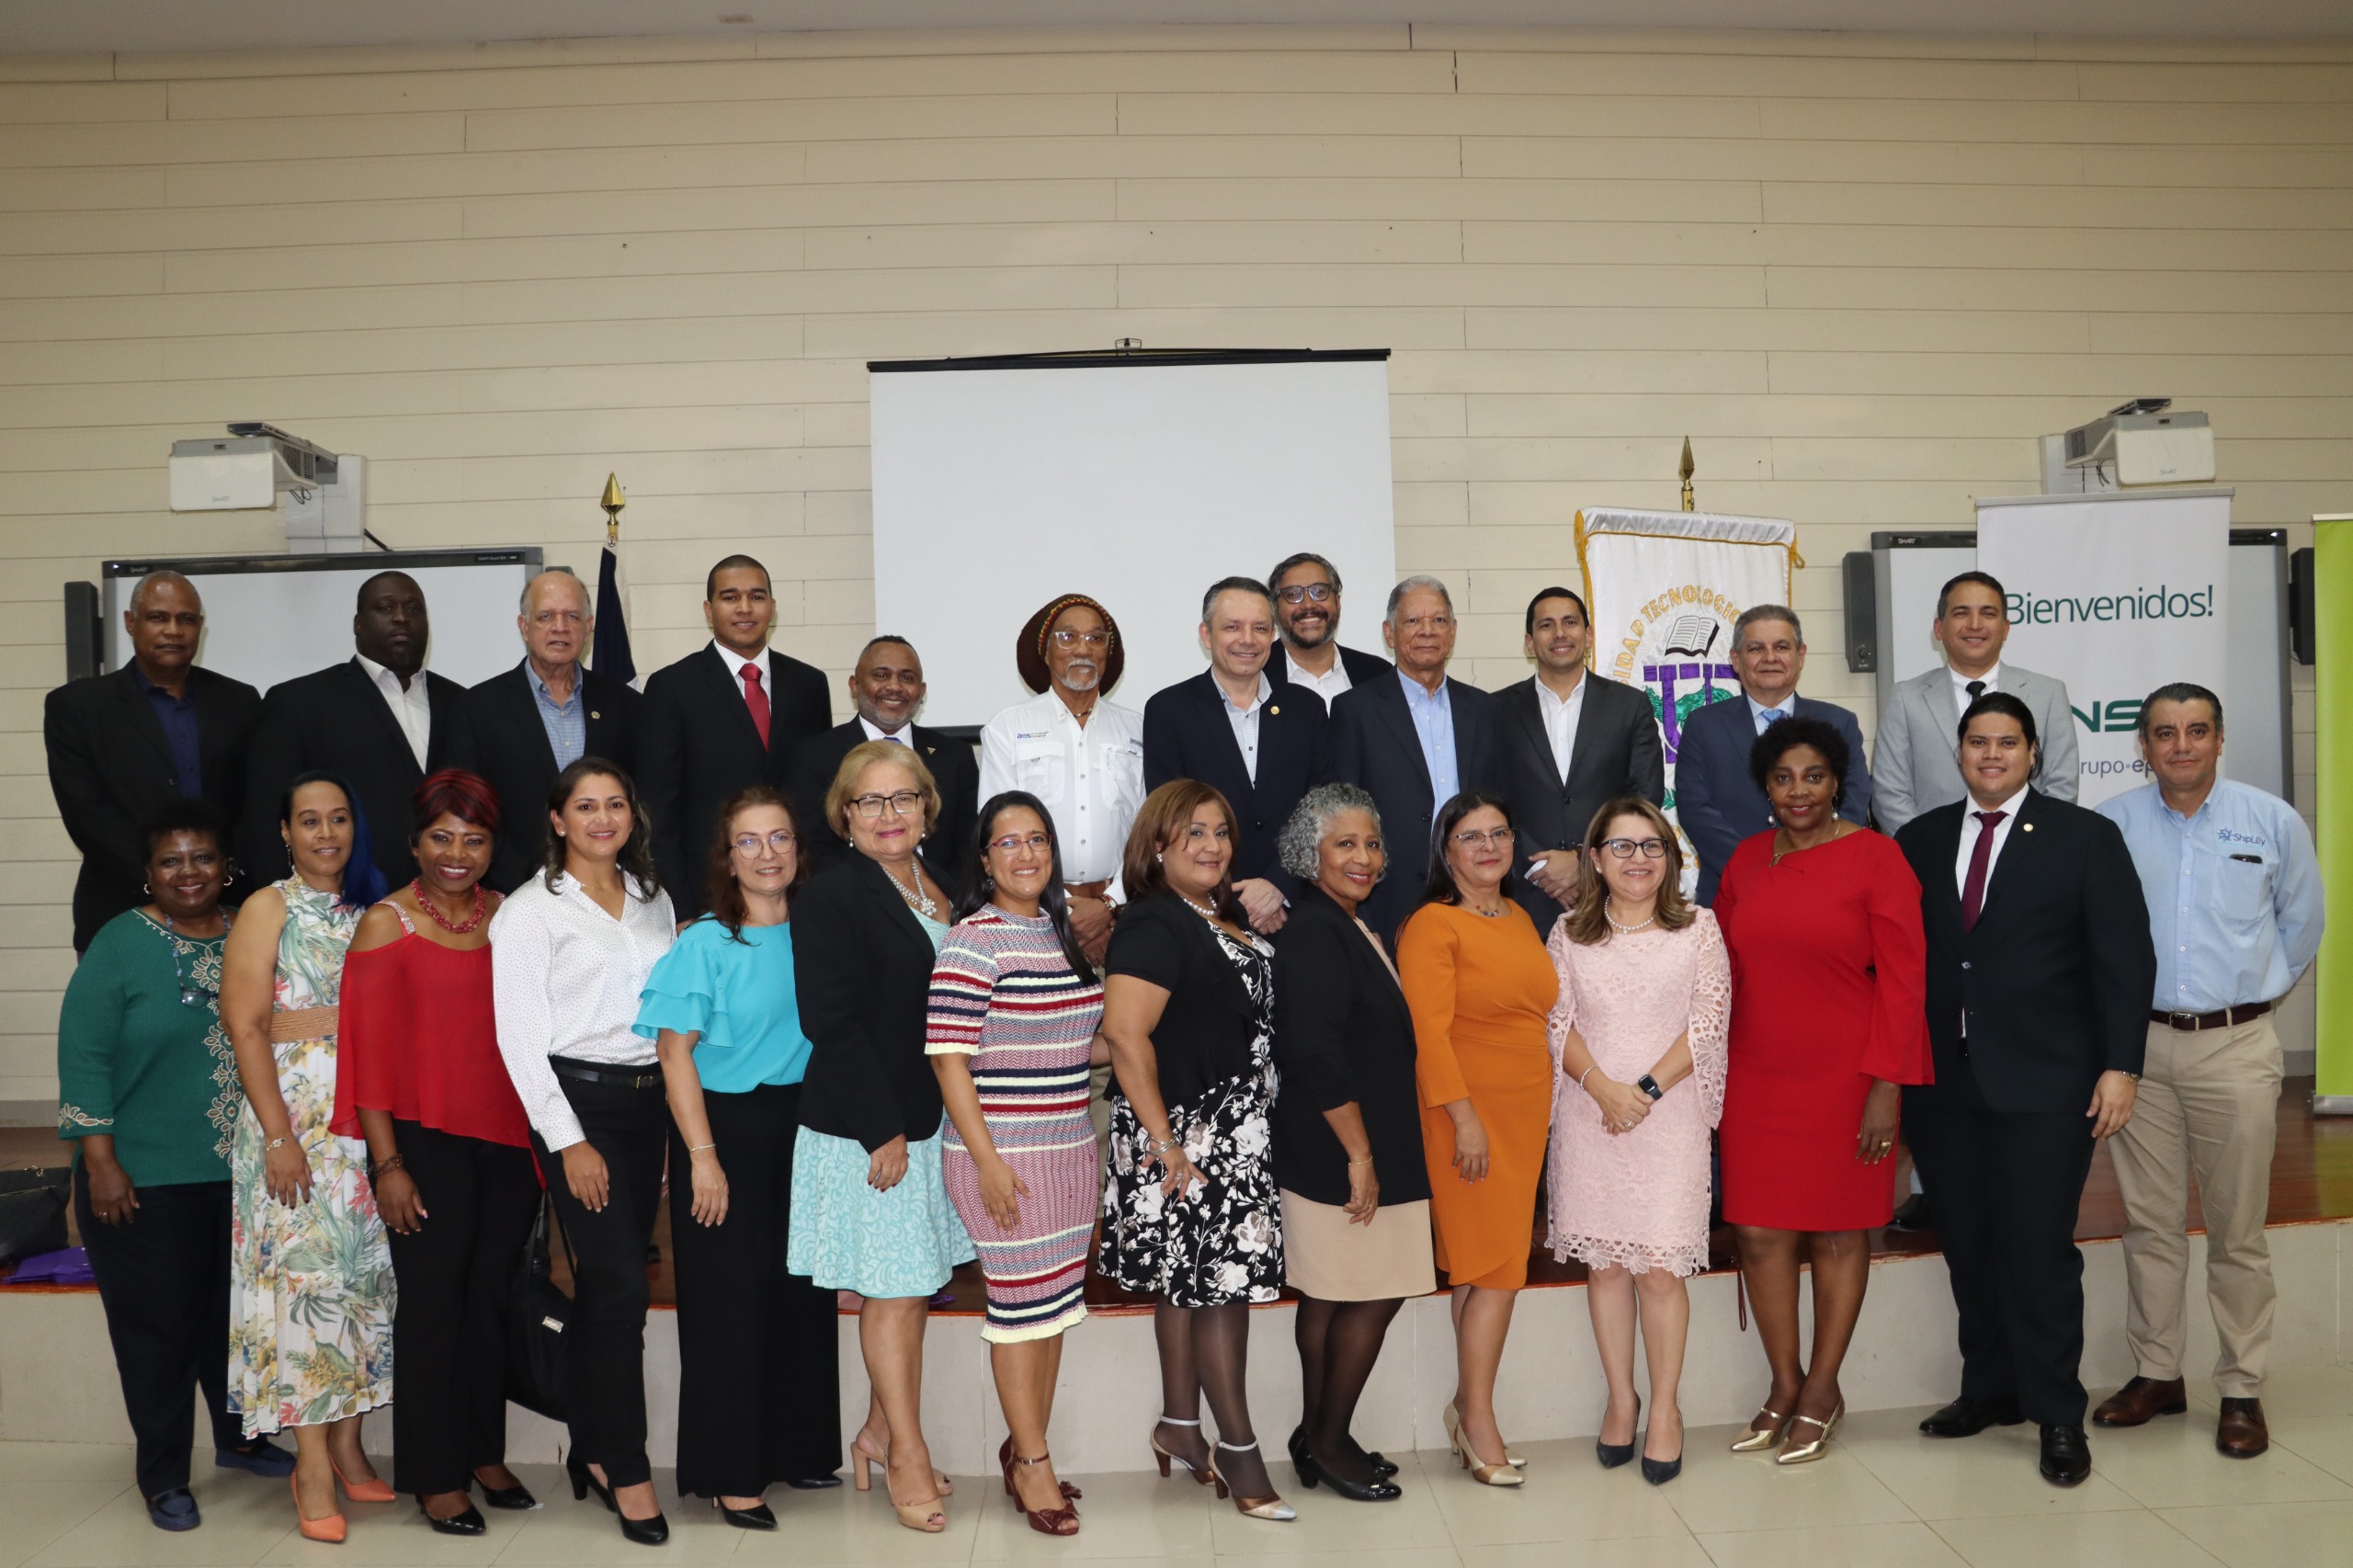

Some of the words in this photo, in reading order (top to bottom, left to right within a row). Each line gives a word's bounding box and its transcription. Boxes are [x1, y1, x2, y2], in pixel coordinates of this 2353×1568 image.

[1641, 585, 1743, 627] TECNOLOGIC
[2005, 585, 2213, 625] Bienvenidos!
[2070, 699, 2143, 733] NS
